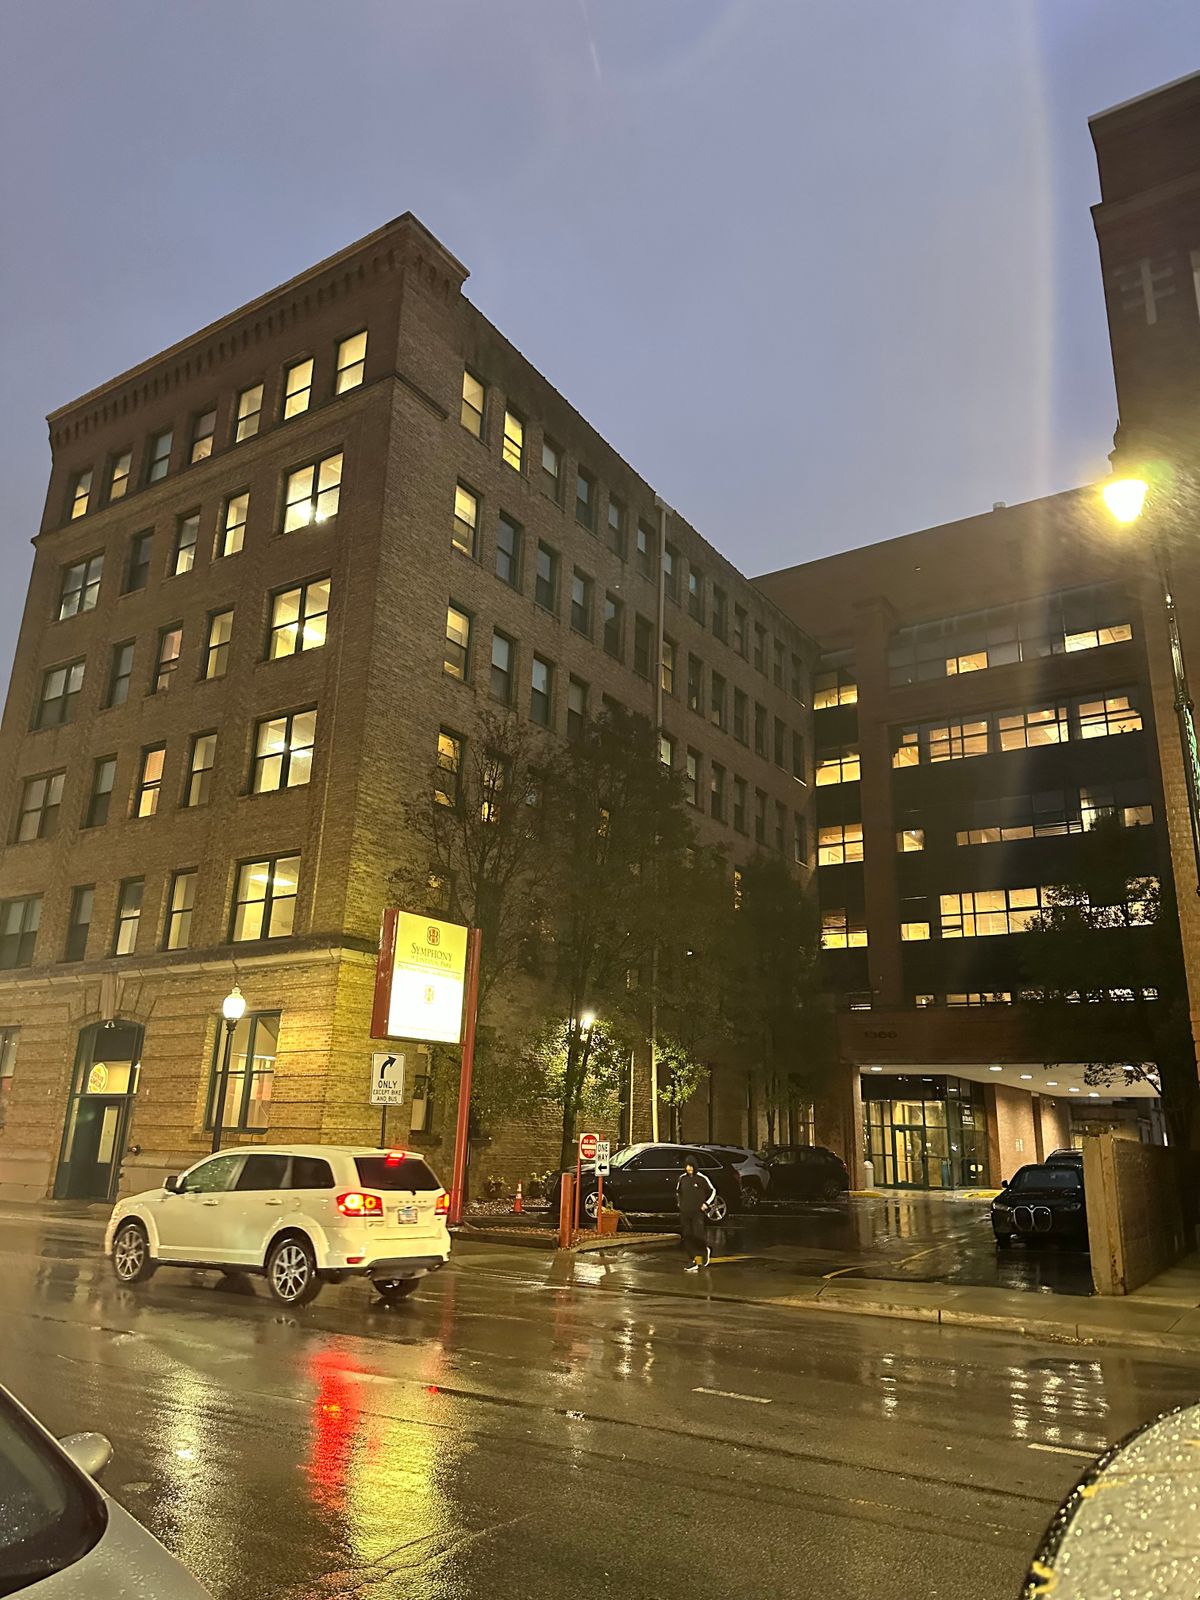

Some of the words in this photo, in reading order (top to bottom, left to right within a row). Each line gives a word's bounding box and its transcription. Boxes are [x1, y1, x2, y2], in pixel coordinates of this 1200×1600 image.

[411, 942, 453, 962] SYMPHONY
[378, 1080, 398, 1088] ONLY
[598, 1144, 608, 1152] ONE
